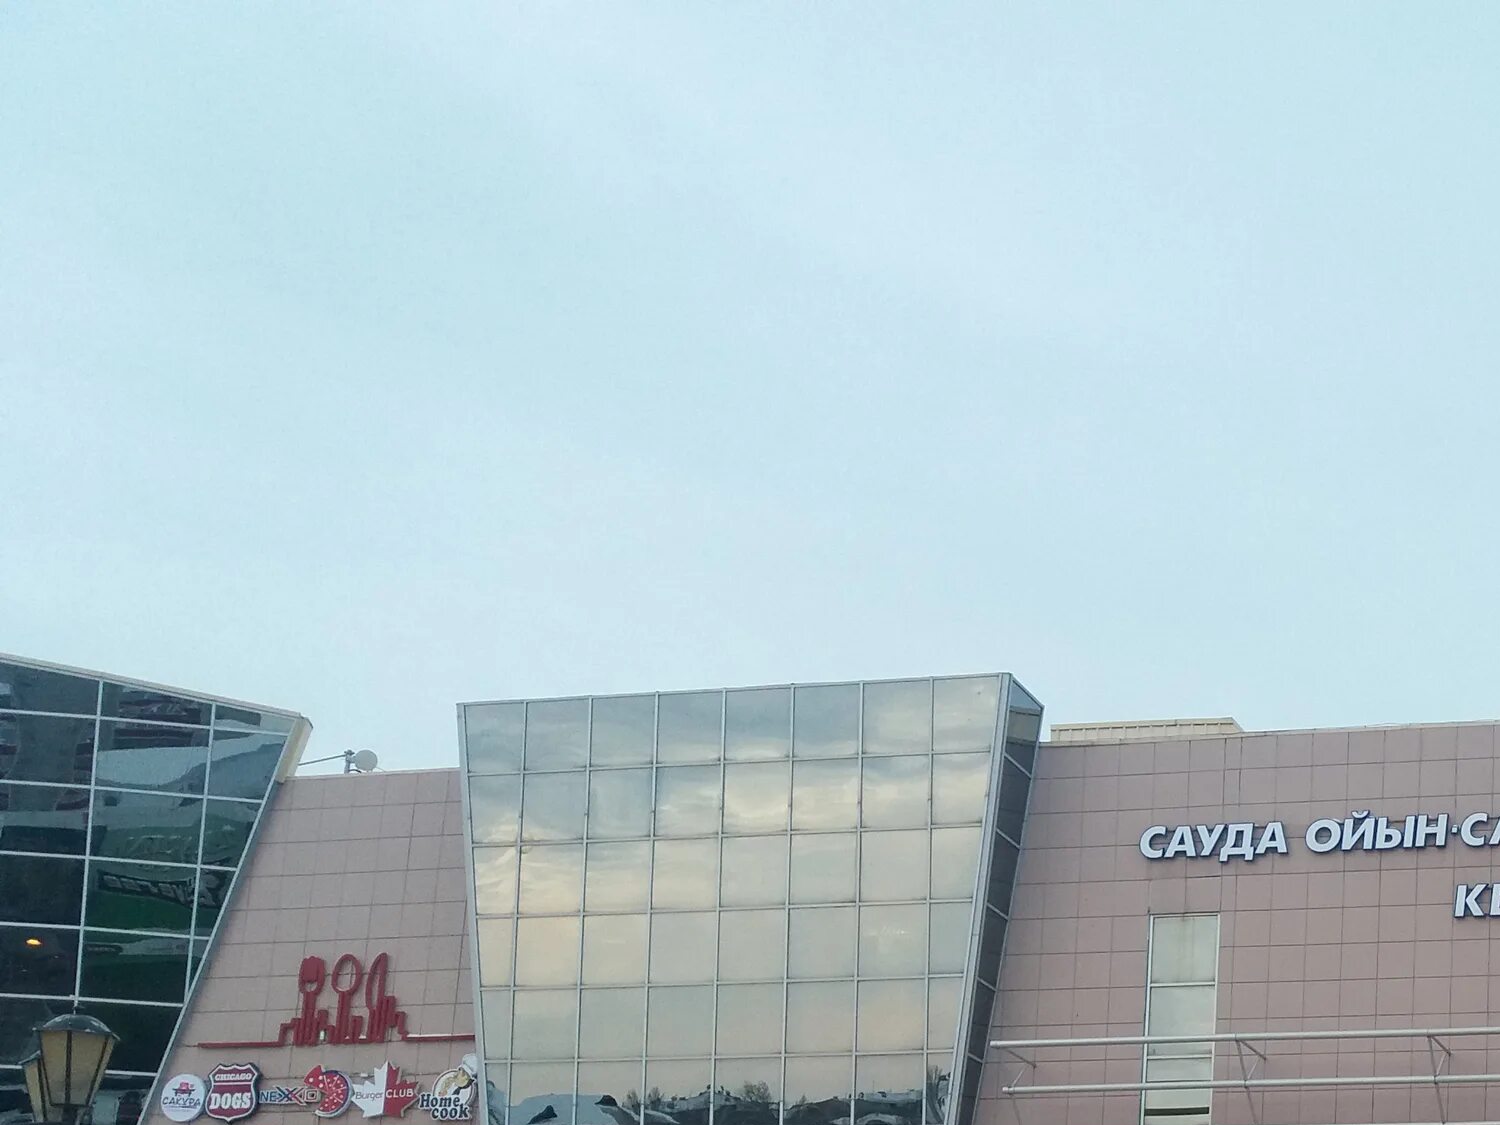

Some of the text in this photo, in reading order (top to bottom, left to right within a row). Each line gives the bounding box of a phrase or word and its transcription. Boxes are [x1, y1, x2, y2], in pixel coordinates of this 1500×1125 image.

[1138, 821, 1288, 862] САУДА
[214, 1073, 252, 1081] CHICAGO
[162, 1096, 201, 1106] САКУРА
[209, 1092, 252, 1110] DOGS
[355, 1088, 414, 1101] Burger CLUB
[431, 1106, 470, 1120] cook
